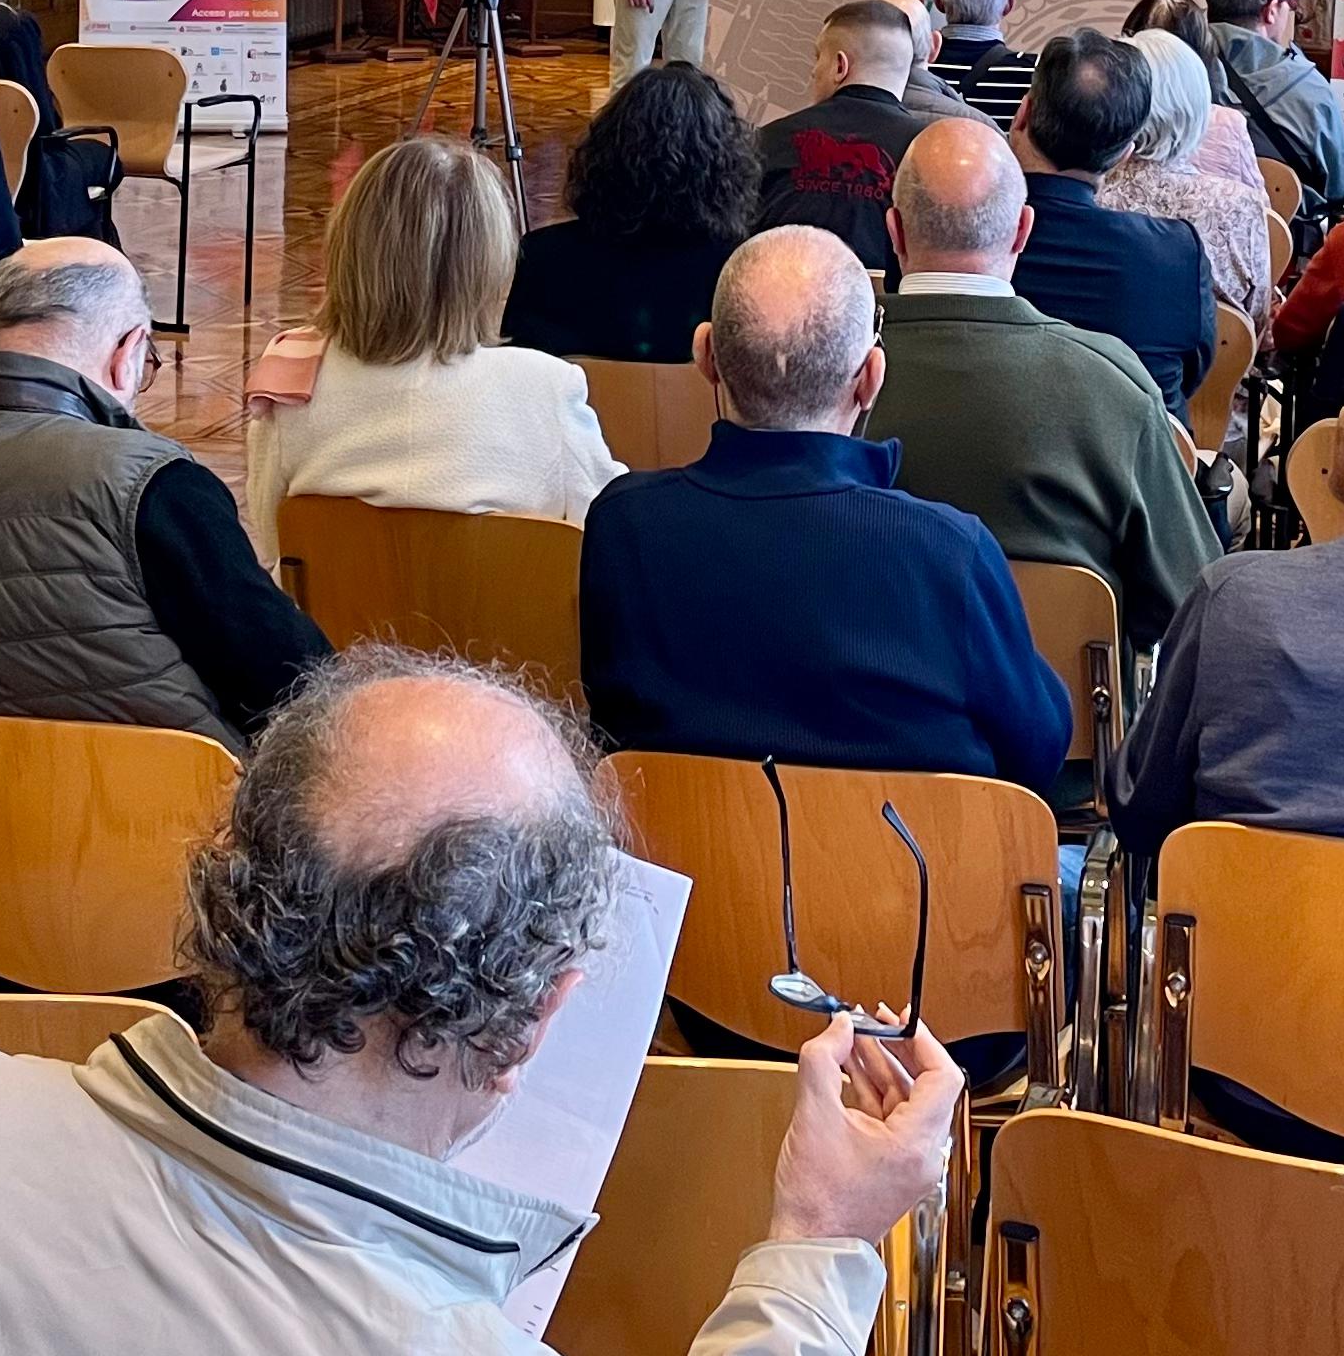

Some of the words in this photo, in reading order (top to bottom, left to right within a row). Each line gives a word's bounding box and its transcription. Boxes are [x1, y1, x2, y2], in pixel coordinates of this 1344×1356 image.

[191, 8, 226, 18] Acceso
[228, 9, 250, 19] para
[252, 7, 279, 18] todos
[794, 179, 842, 193] SINCE
